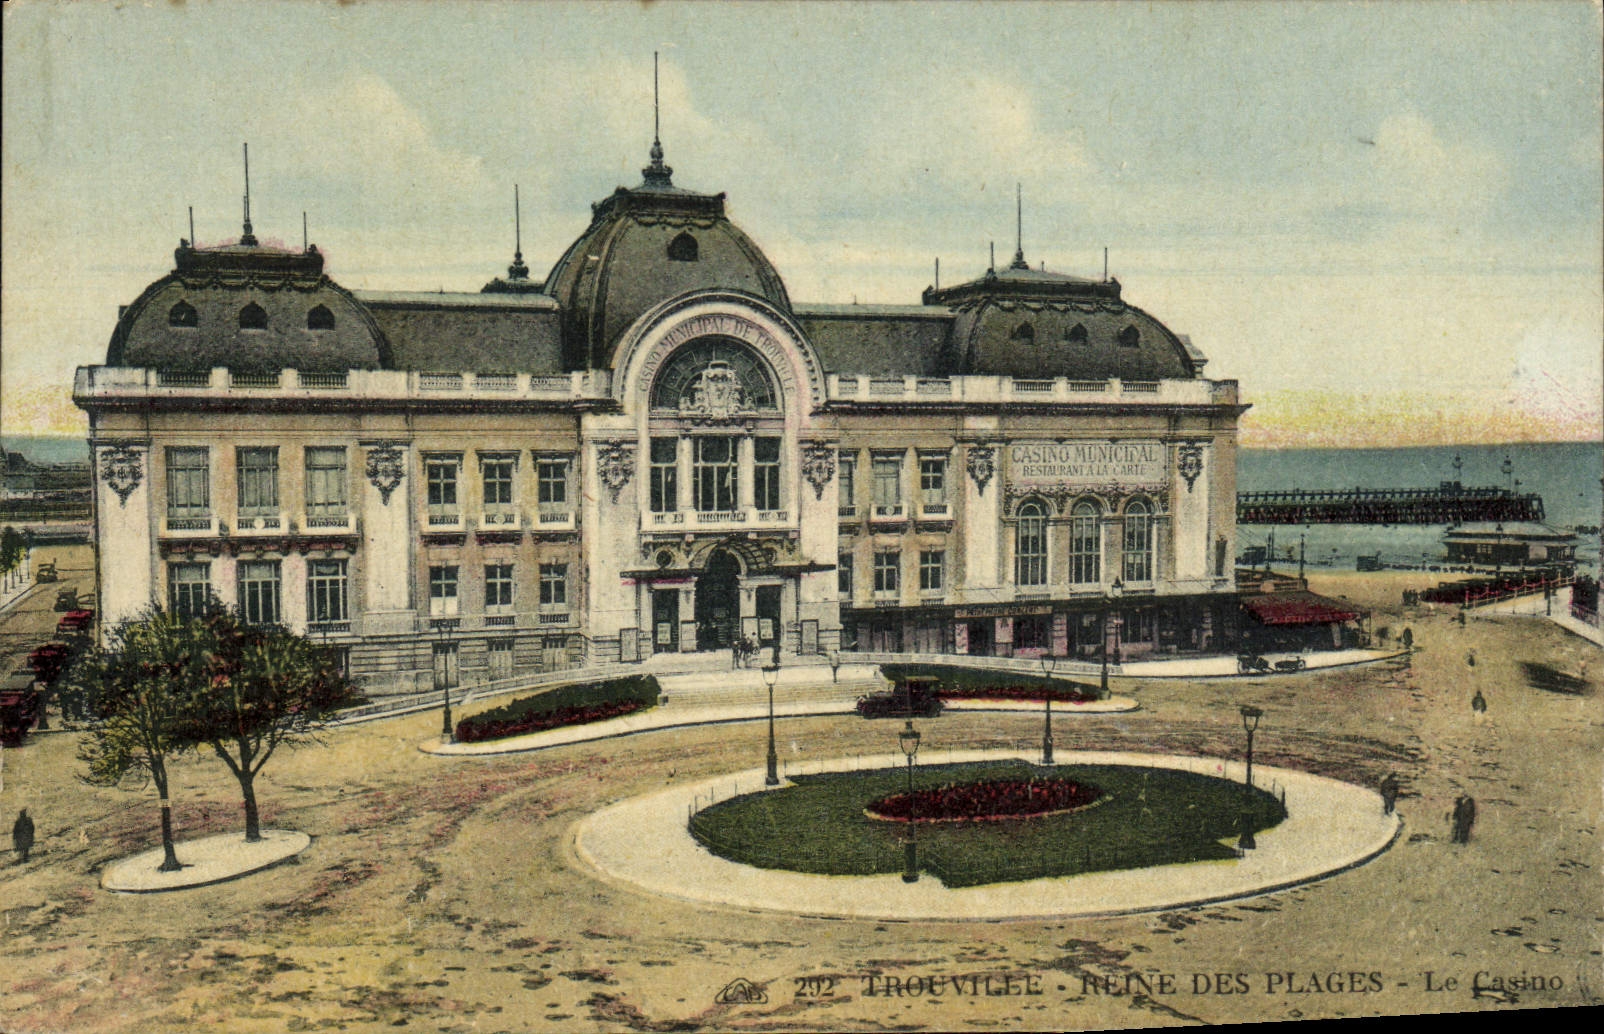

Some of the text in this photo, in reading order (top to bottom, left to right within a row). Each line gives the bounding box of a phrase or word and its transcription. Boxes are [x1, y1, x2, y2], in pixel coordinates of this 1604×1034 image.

[1012, 445, 1158, 463] CASINO MUNICIPAL
[1022, 465, 1085, 477] RESTAURANT
[1112, 464, 1147, 476] CARTE
